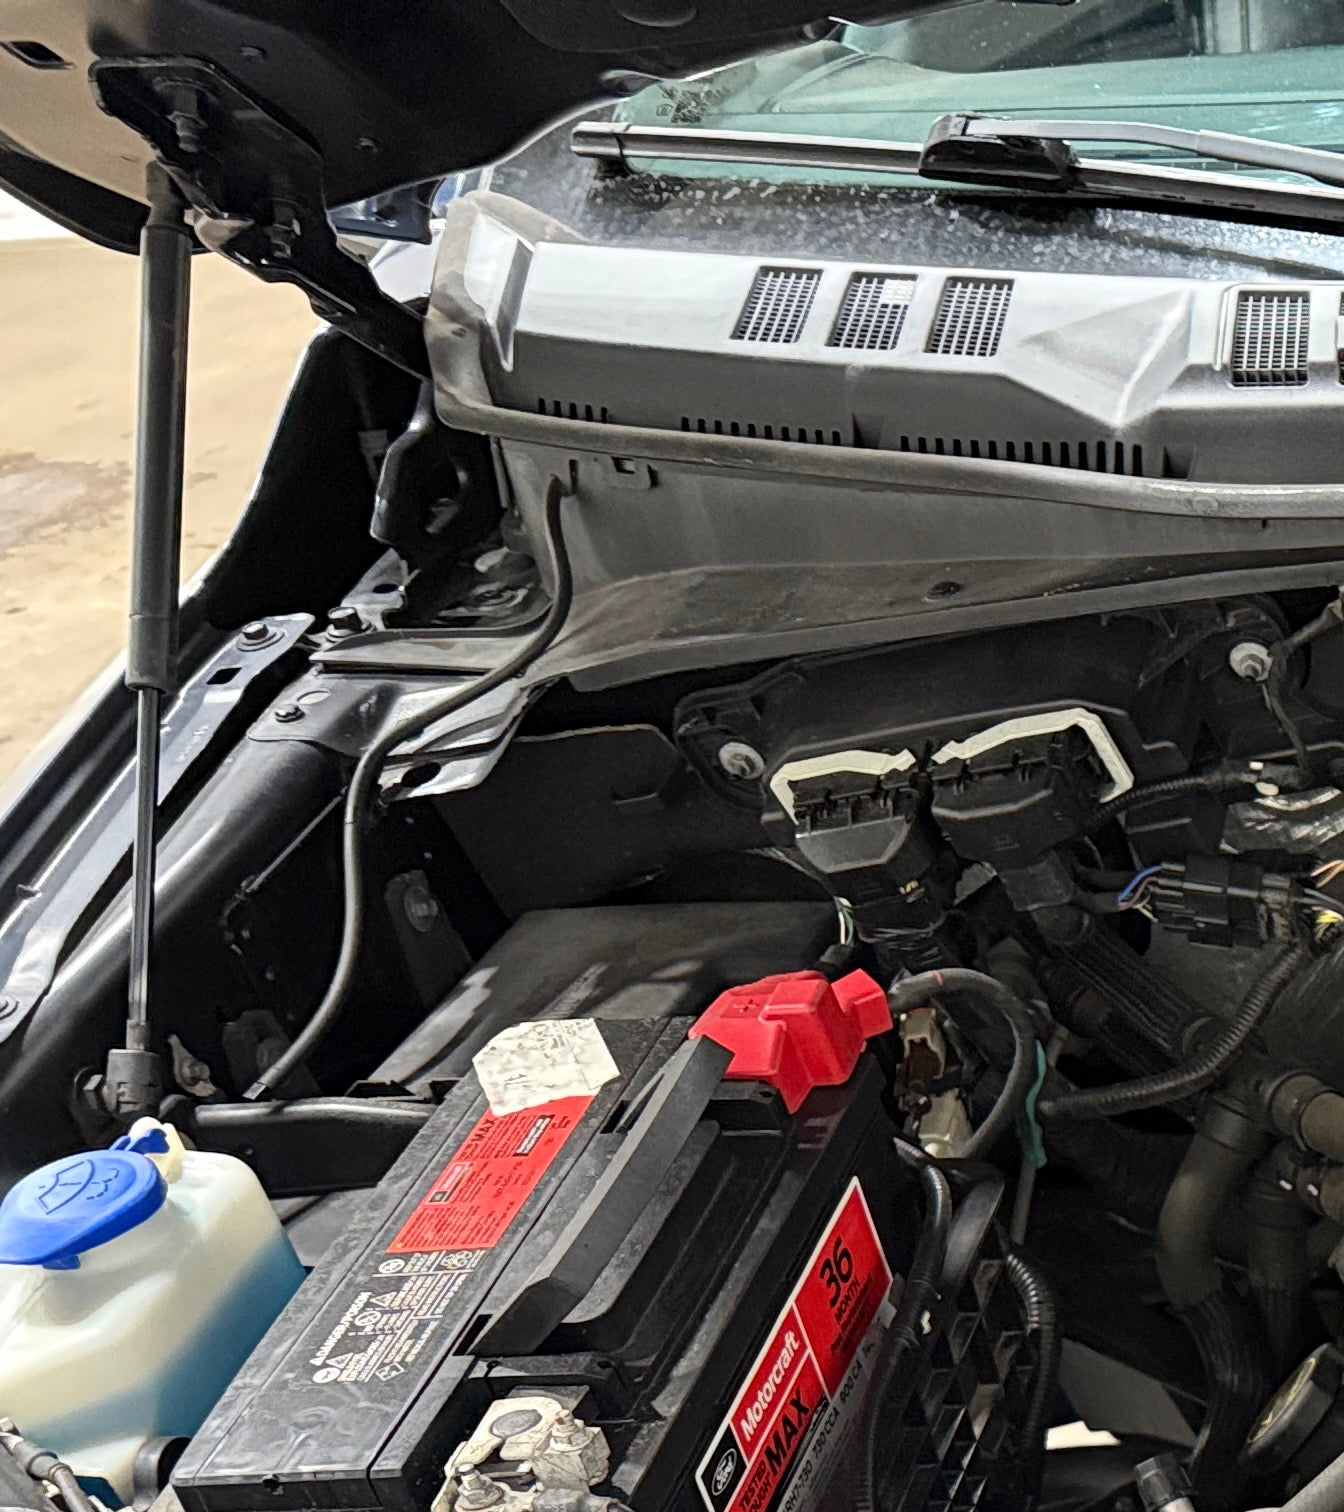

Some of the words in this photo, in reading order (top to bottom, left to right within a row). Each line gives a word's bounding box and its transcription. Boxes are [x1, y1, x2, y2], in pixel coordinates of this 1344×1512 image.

[819, 1236, 853, 1309] 36
[834, 1275, 861, 1325] MONTH
[740, 1330, 800, 1442] Motorcraft
[812, 1431, 828, 1460] 730
[824, 1406, 840, 1436] CCA
[839, 1374, 854, 1404] 900
[850, 1358, 861, 1380] CA
[764, 1387, 809, 1476] MAX
[713, 1450, 736, 1494] Ford
[738, 1459, 767, 1512] TESTED
